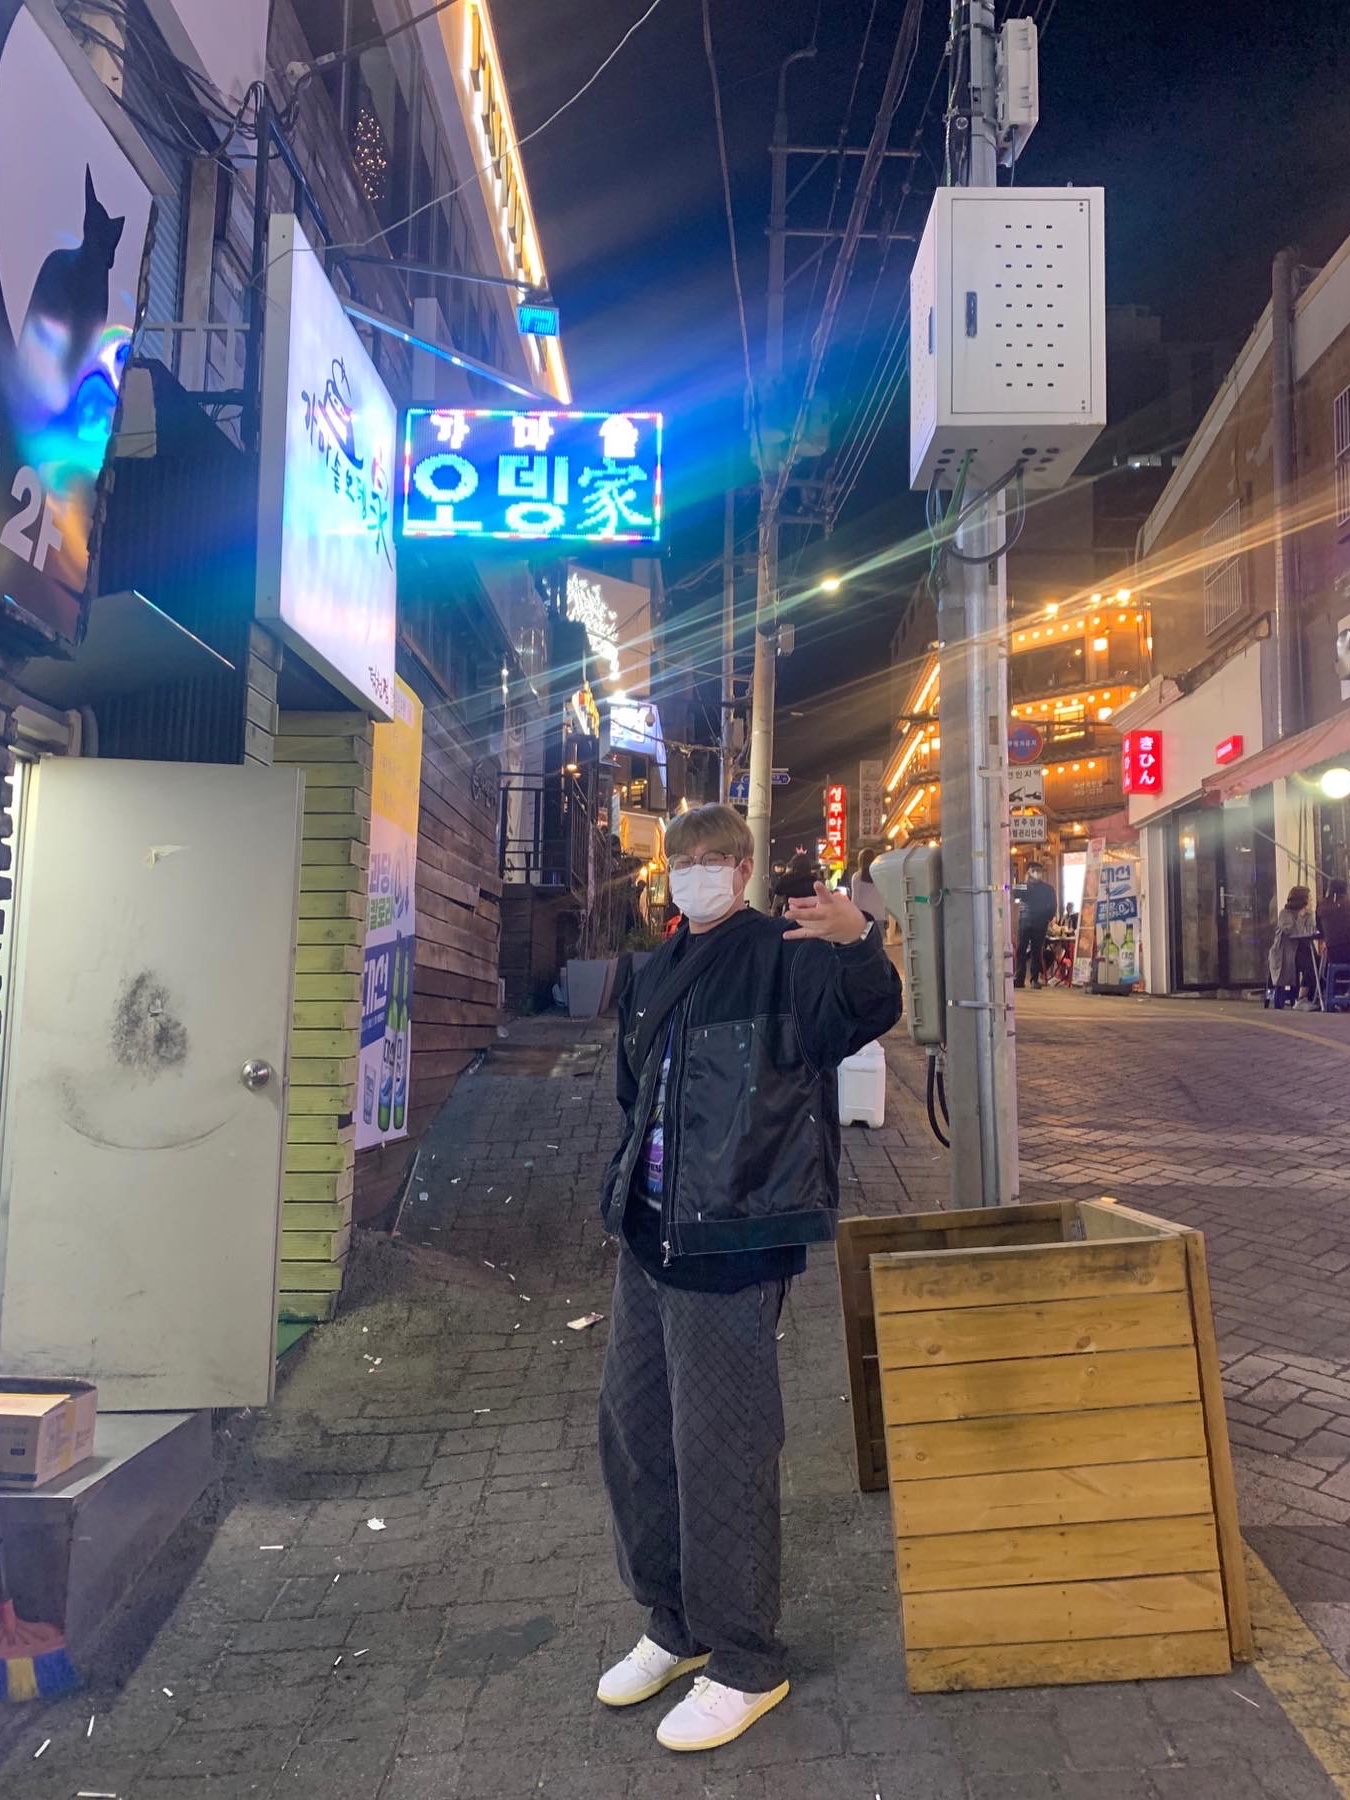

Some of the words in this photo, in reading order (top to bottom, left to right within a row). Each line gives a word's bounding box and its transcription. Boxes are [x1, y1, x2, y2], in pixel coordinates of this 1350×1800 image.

[0, 465, 64, 573] 2F
[1139, 736, 1155, 785] きひん
